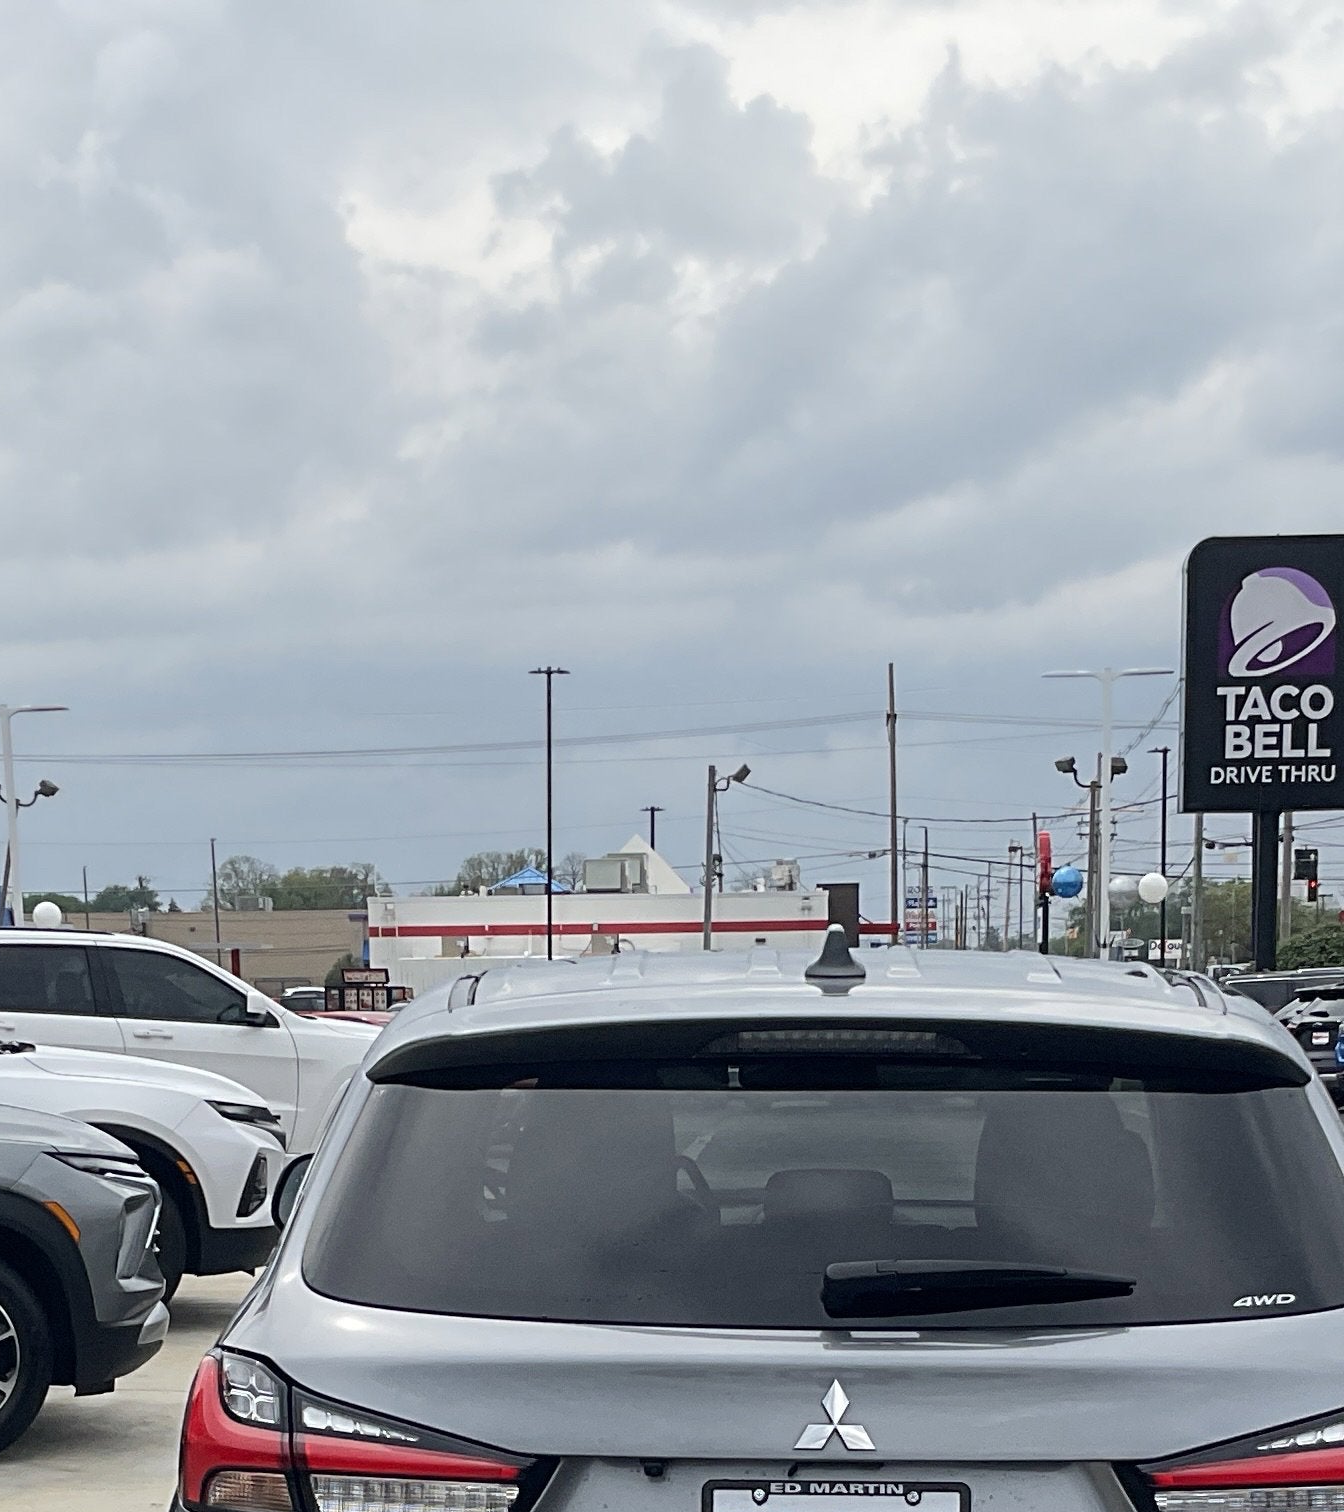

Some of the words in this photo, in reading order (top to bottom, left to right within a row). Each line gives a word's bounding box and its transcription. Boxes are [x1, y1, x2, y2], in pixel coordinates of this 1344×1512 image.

[1217, 684, 1334, 720] TACO
[1225, 723, 1331, 759] BELL
[1210, 766, 1273, 784] DRIVE
[1278, 765, 1336, 782] THRU
[1233, 1294, 1296, 1307] 4WD
[770, 1482, 802, 1494] ED
[809, 1483, 904, 1495] MARTIN
